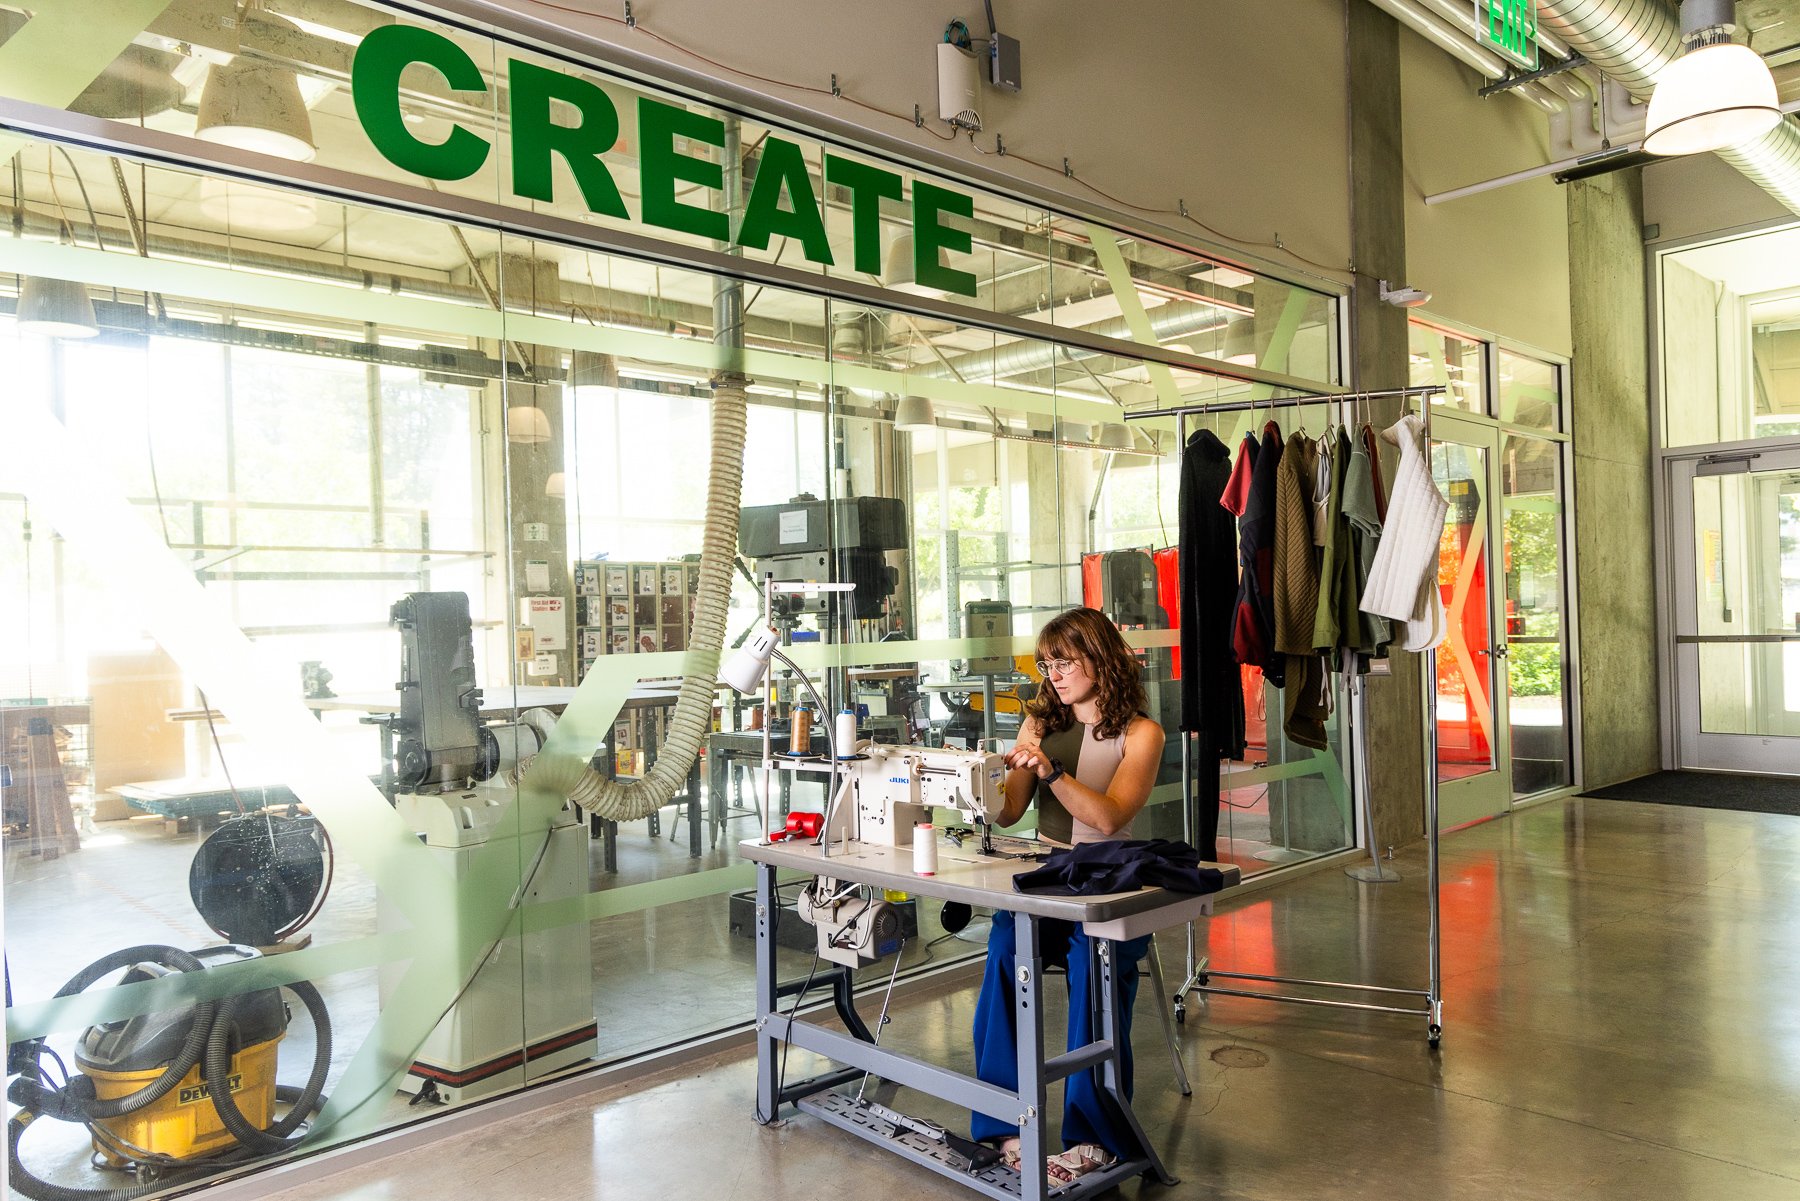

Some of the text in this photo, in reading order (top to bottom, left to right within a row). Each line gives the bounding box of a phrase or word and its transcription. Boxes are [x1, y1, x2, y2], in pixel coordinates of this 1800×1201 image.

[1489, 0, 1527, 58] EXIT
[351, 24, 977, 298] CREATE
[180, 1075, 242, 1103] DEWLT
